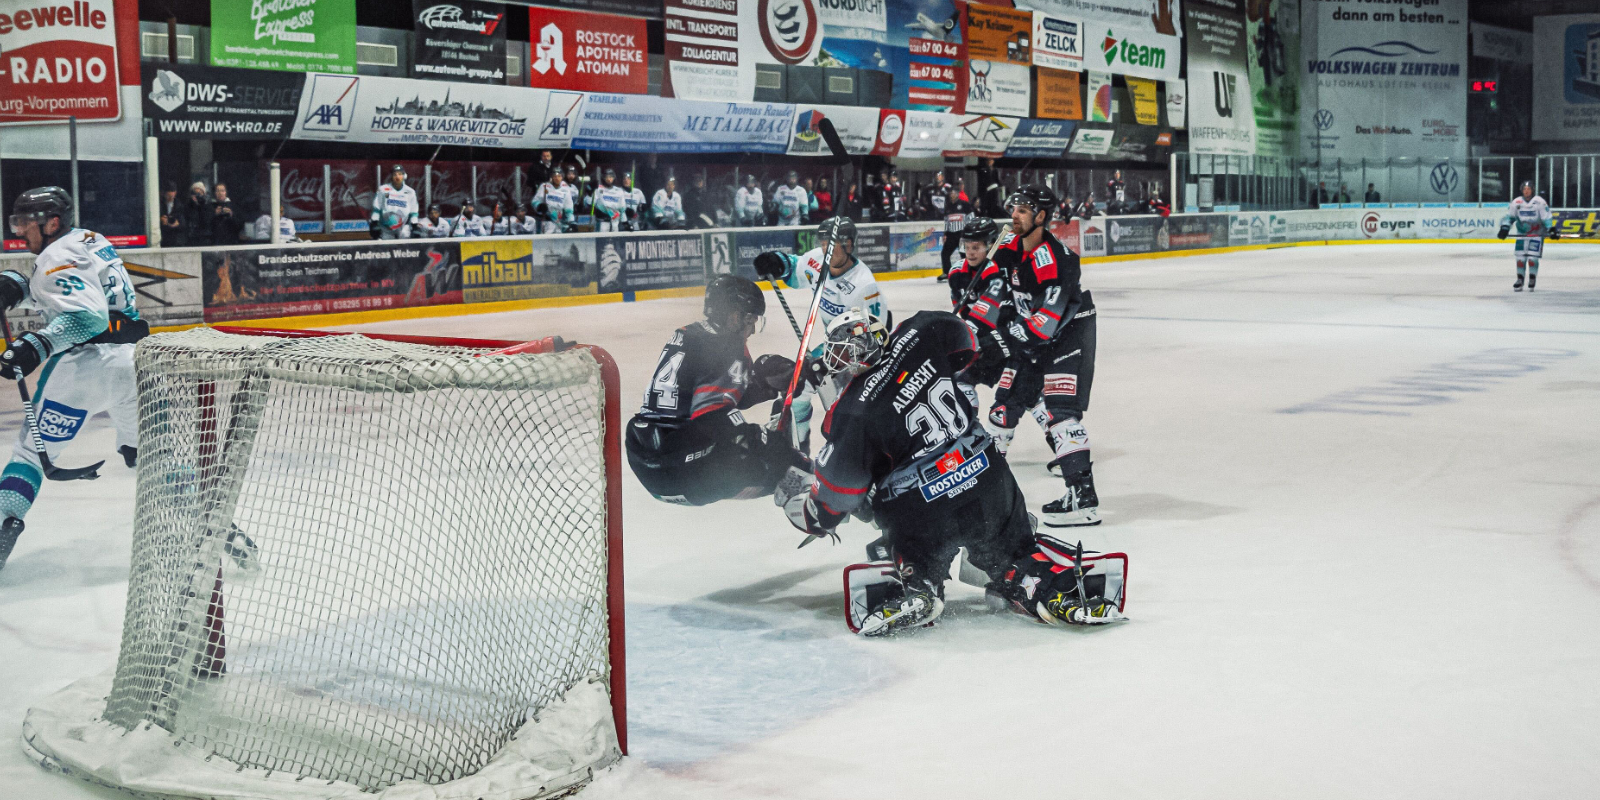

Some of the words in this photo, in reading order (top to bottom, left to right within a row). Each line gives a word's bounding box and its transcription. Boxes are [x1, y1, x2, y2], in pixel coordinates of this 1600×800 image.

[1333, 6, 1369, 22] dann
[1373, 11, 1395, 22] am
[1400, 9, 1445, 24] besten
[254, 10, 315, 45] Express
[687, 21, 737, 38] TRANSPORTE
[576, 30, 635, 48] ROSTOCK
[1045, 33, 1077, 54] ZELCK
[576, 46, 643, 63] APOTHEKE
[682, 46, 737, 63] ZOLLAGENTUR
[922, 42, 931, 53] 67
[932, 43, 943, 55] 00
[1120, 37, 1166, 70] team
[576, 60, 630, 76] ATOMAN
[921, 66, 931, 77] 67
[931, 67, 941, 79] 00
[1308, 60, 1397, 76] VOLKSWAGEN
[1400, 62, 1460, 77] ZENTRUM
[1317, 78, 1375, 89] AUTOHAUS
[304, 104, 342, 126] AXA
[726, 102, 762, 117] Thomas
[159, 119, 283, 134] WWW.DWS-HRO.DE
[371, 116, 414, 131] HOPPE
[415, 118, 423, 131] &
[427, 118, 498, 134] WASKEWITZ
[498, 122, 526, 136] OHG
[540, 117, 569, 136] AXA
[683, 115, 792, 133] METALLBAU
[1356, 125, 1371, 135] Das
[1422, 218, 1495, 228] NORDMANN
[259, 252, 352, 265] Brandschutzservice
[354, 249, 391, 260] Andreas
[393, 249, 420, 258] Weber
[625, 241, 637, 260] PV
[638, 240, 677, 259] MONTAGE
[259, 269, 284, 278] Inhaber
[286, 268, 303, 277] Sven
[305, 267, 339, 276] Teichmann
[462, 254, 532, 285] mibau
[1045, 285, 1062, 306] 13
[892, 327, 919, 358] ZENTRUM
[892, 357, 938, 415] ALBRECHT
[905, 376, 970, 460] 30
[1070, 428, 1087, 439] HCC
[928, 457, 985, 496] ROSTOCKER
